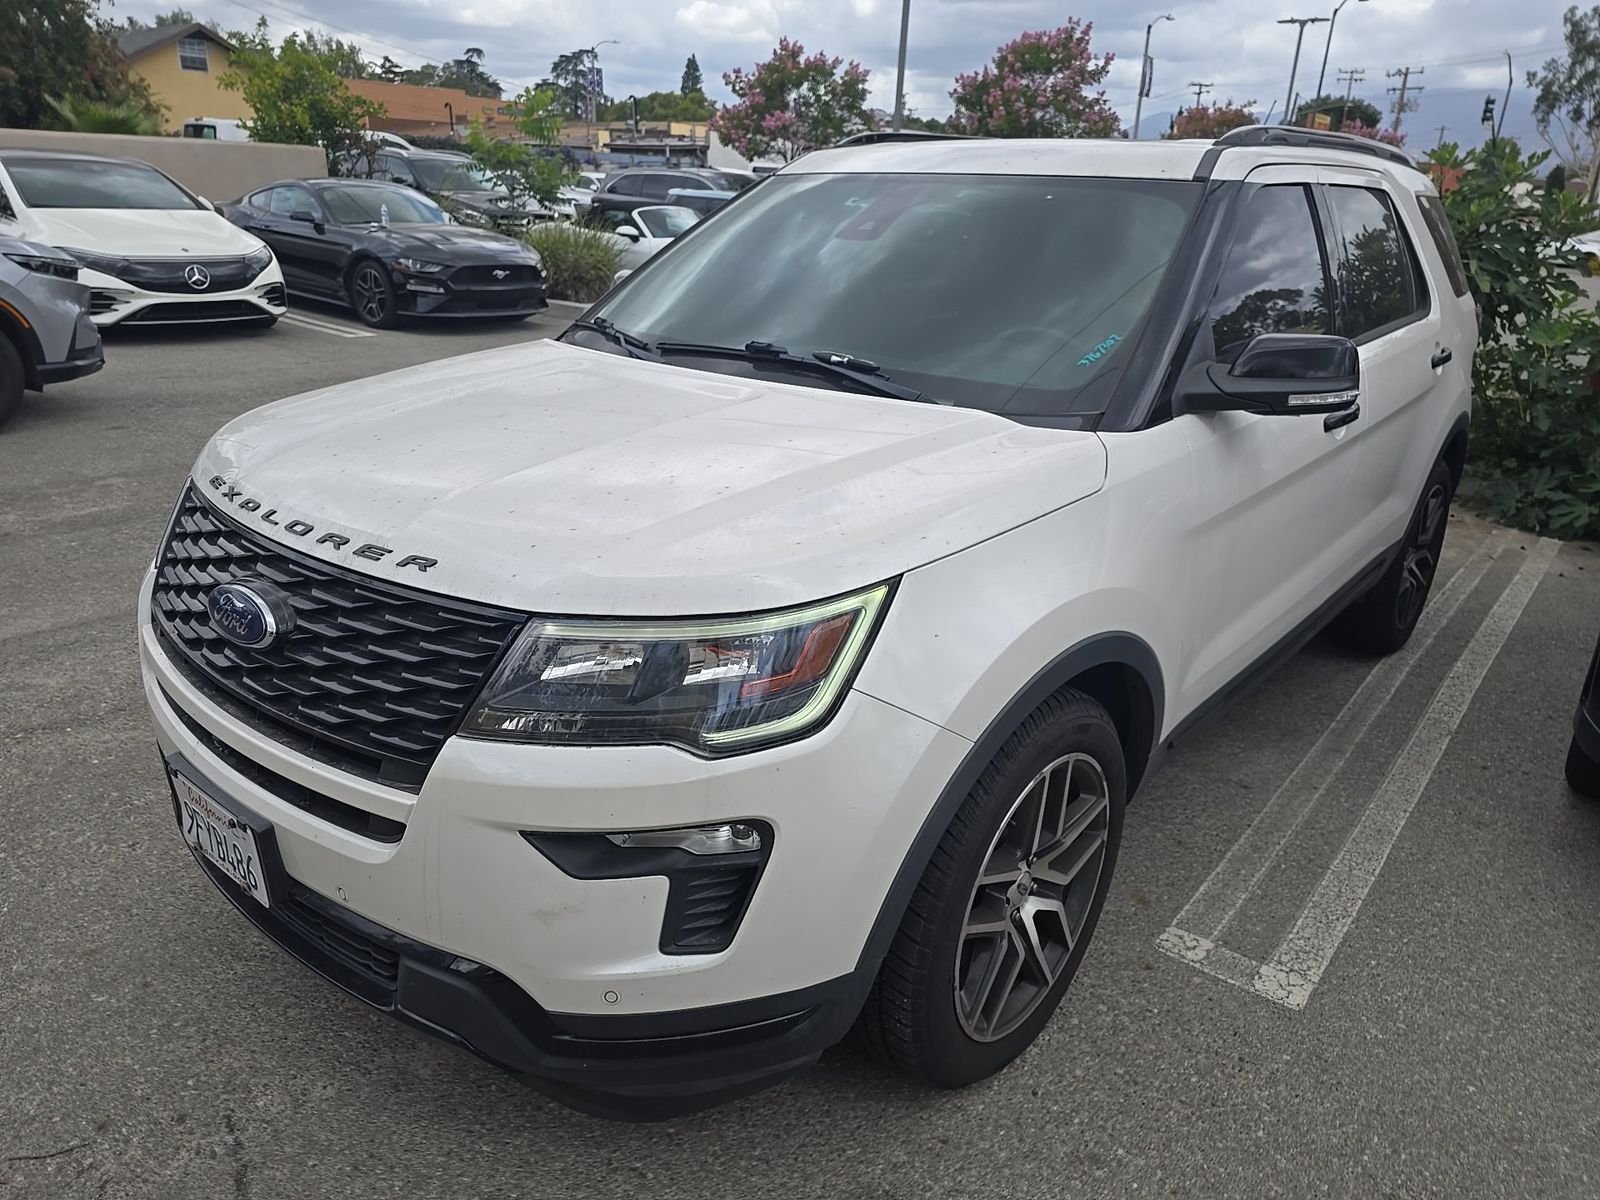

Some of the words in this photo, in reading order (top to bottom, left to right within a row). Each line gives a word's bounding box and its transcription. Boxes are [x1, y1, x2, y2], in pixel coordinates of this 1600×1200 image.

[208, 474, 439, 573] EXPLORER
[214, 595, 252, 636] Ford
[184, 800, 258, 891] 9FYB486
